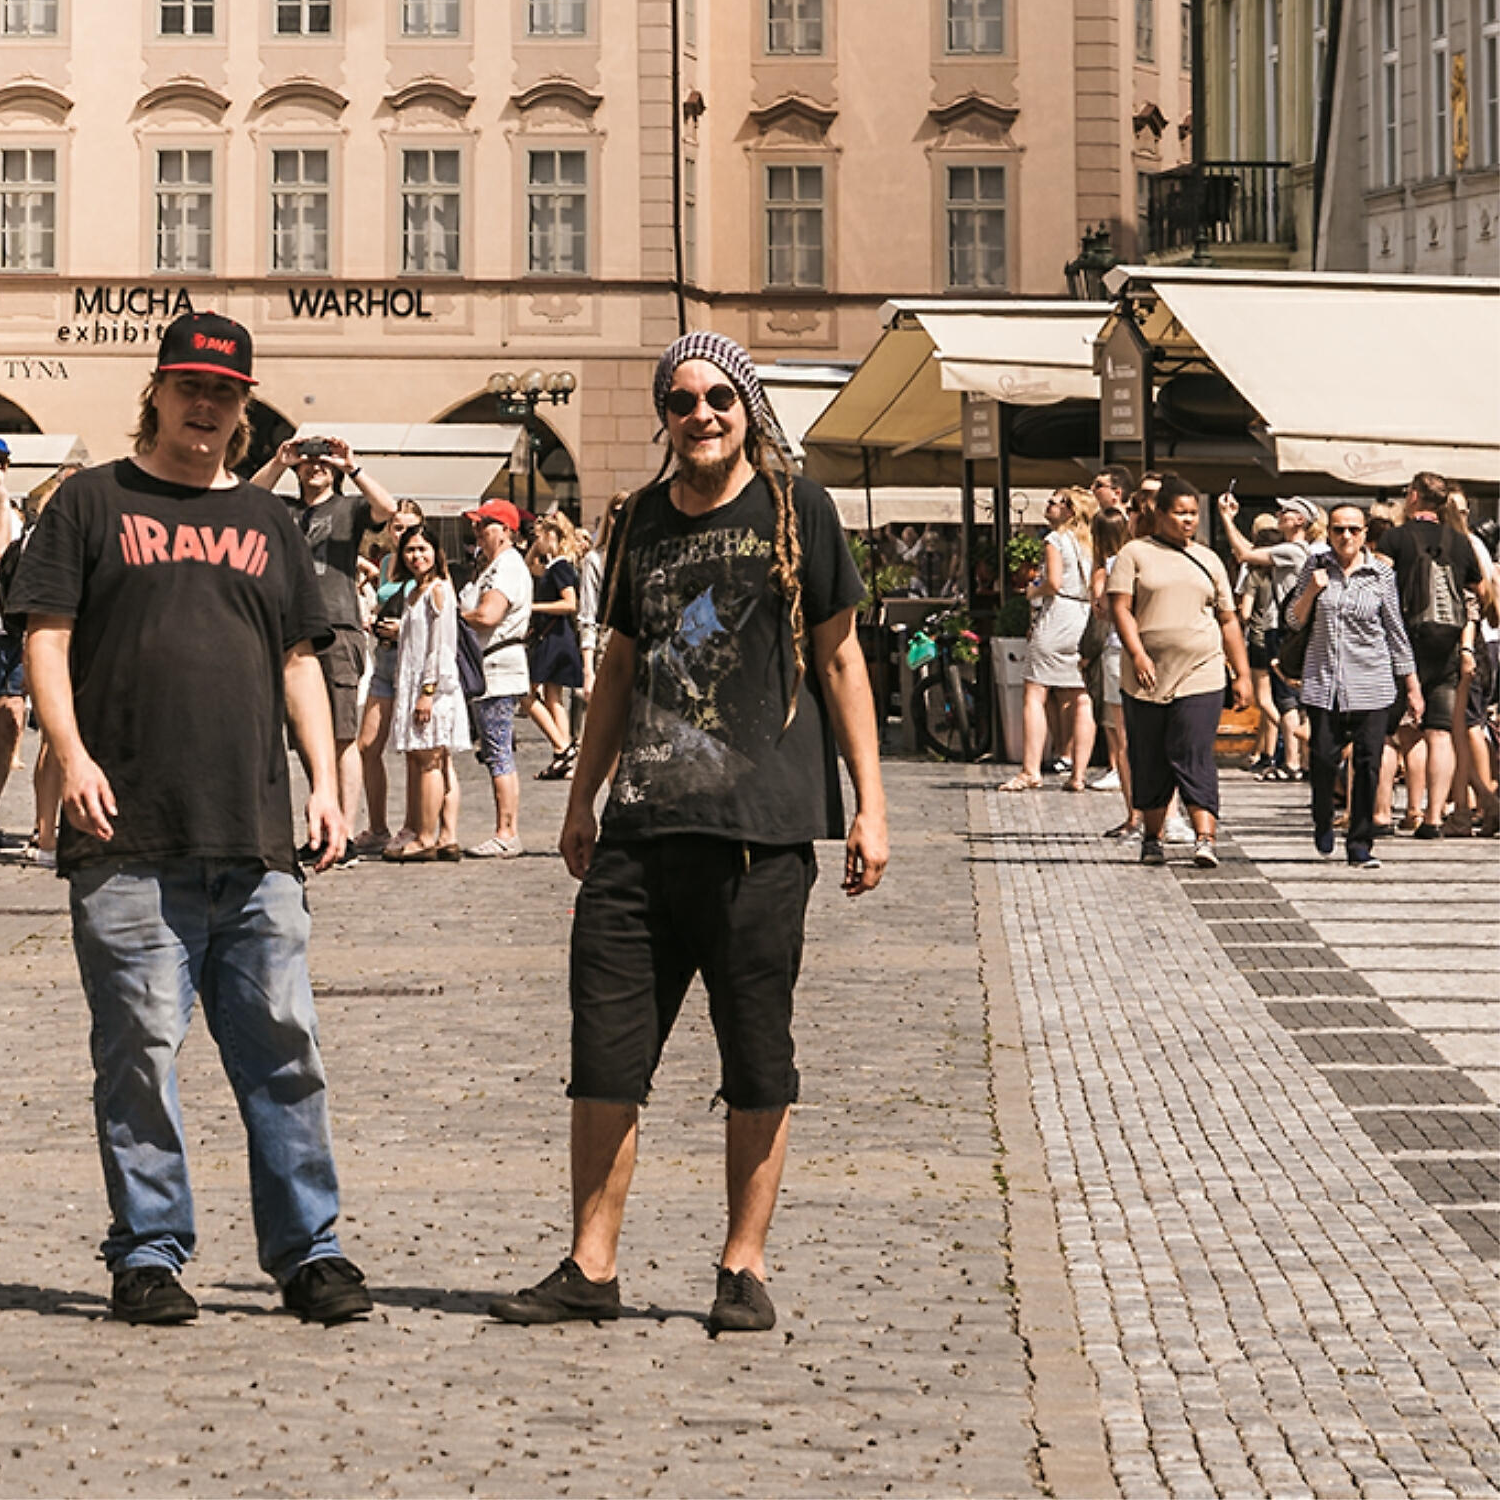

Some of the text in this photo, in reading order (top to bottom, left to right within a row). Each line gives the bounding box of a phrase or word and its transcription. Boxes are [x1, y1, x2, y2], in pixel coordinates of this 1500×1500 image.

[75, 286, 194, 315] MUCHA
[288, 288, 433, 318] WARHOL
[131, 513, 259, 571] RAW
